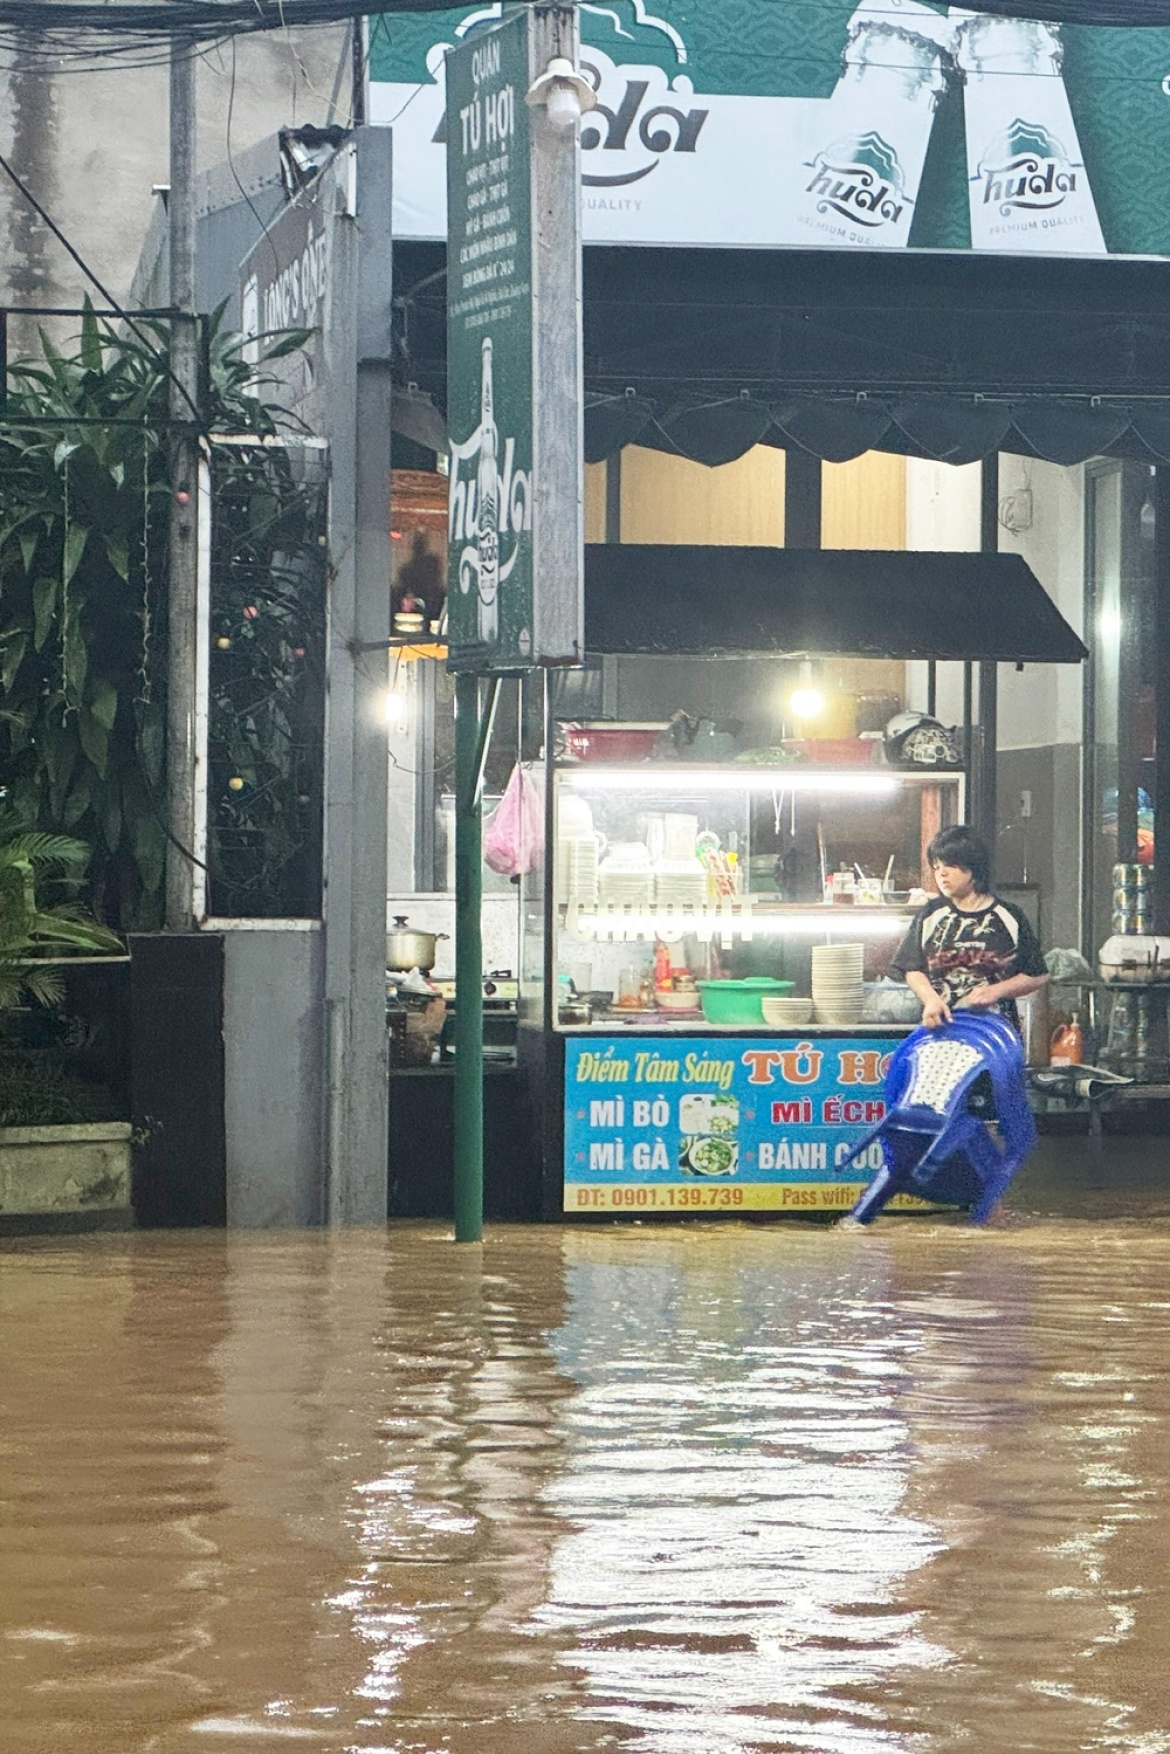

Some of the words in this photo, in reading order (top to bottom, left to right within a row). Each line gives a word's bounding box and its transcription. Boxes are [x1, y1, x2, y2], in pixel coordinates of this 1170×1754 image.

[472, 38, 500, 86] QUÁN
[460, 90, 481, 155] TÚ
[486, 84, 514, 152] HỢI
[806, 161, 903, 223] huda
[983, 159, 1076, 205] huda
[989, 221, 1038, 235] PREMIUM
[1042, 215, 1085, 230] QUALITY
[576, 1045, 629, 1082] Điểm
[634, 1052, 679, 1082] Tâm
[682, 1050, 735, 1090] Sáng
[741, 1041, 824, 1085] TÚ
[590, 1094, 624, 1127] MÌ
[633, 1094, 669, 1127] BÒ
[771, 1097, 812, 1125] MÌ
[822, 1094, 886, 1125] ẾCH
[589, 1137, 624, 1171] MÌ
[633, 1137, 670, 1171] GÀ
[758, 1137, 826, 1170] BÁNH
[577, 1188, 604, 1206] ĐT:
[612, 1188, 743, 1206] 0901.139.739
[782, 1188, 816, 1205] Pass
